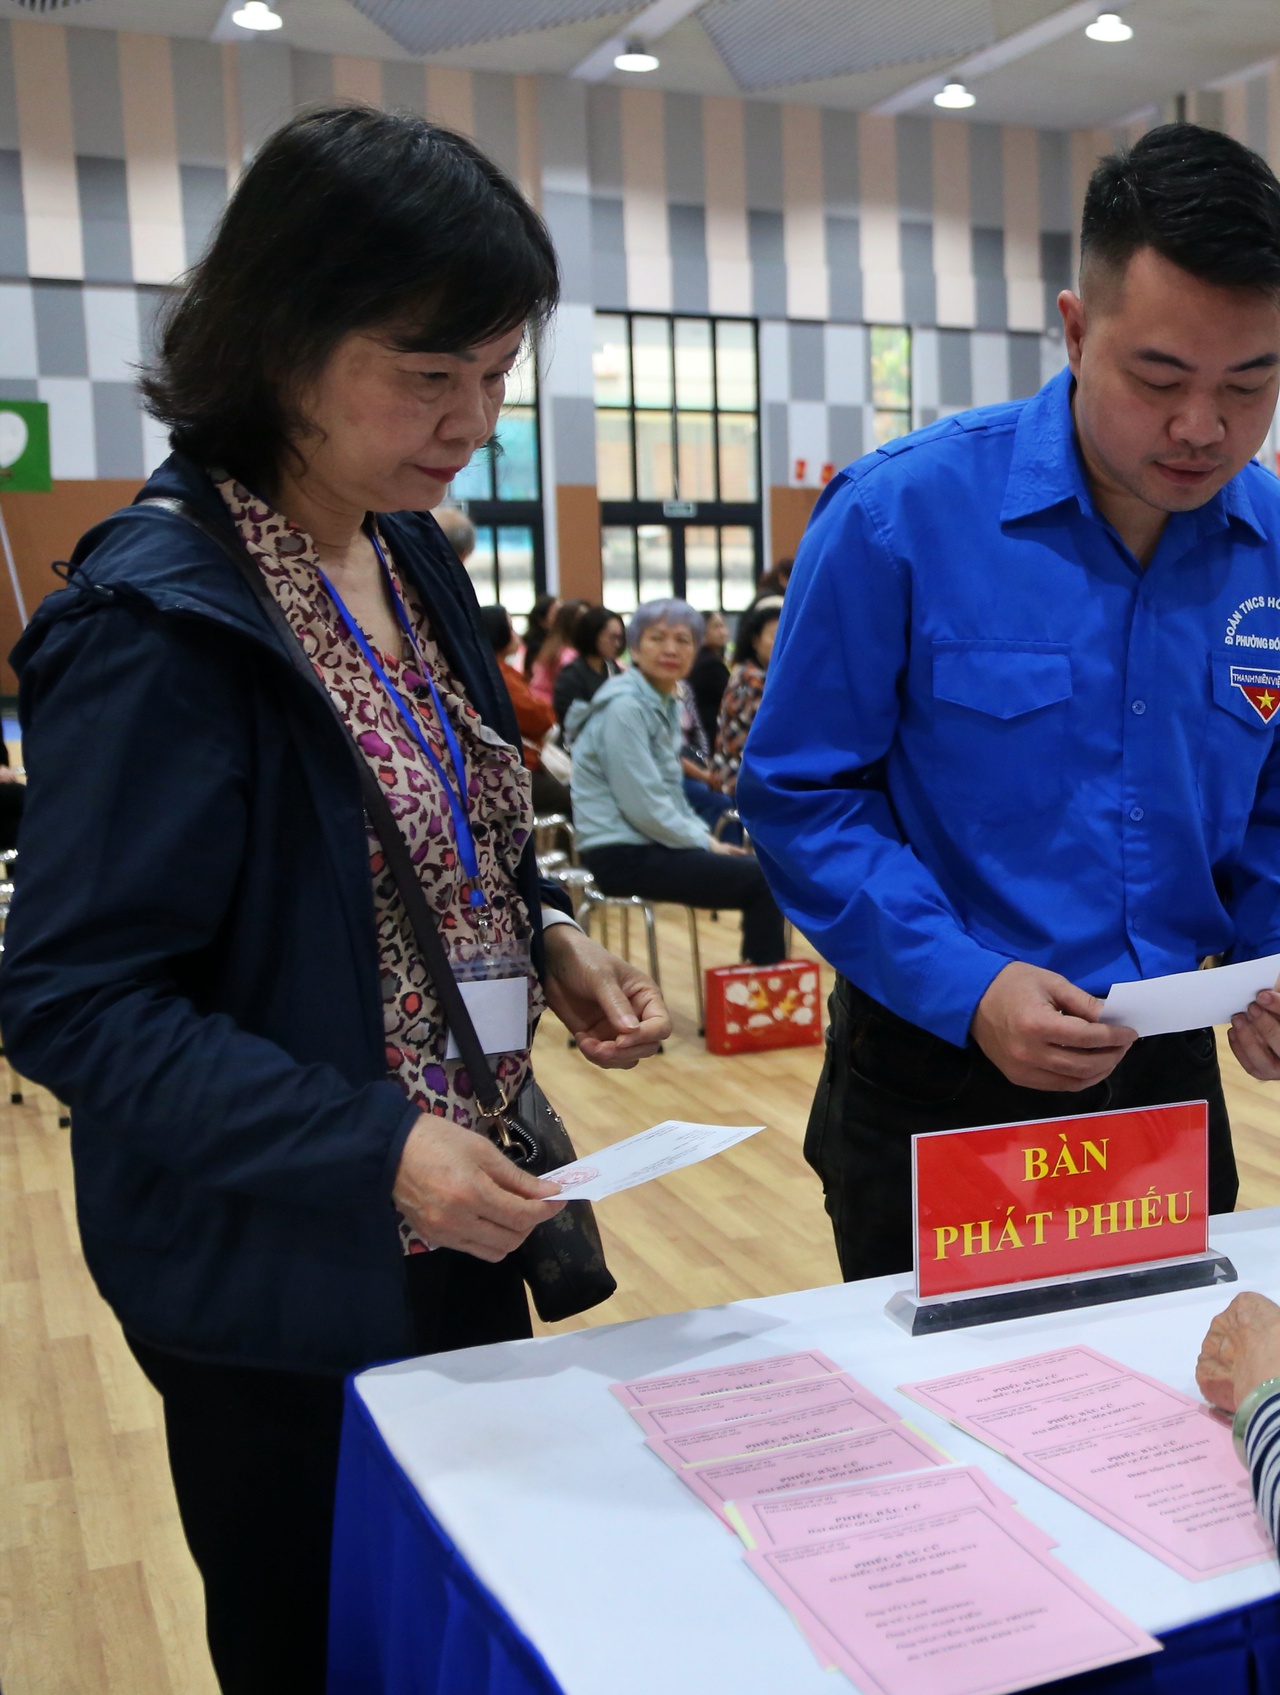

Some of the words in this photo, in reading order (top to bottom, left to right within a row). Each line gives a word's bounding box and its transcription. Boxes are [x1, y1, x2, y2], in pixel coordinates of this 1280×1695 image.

[1225, 610, 1243, 645] ĐOÀN
[1239, 595, 1265, 614] TNCS
[1235, 633, 1268, 649] PHƯỜNG
[1021, 1133, 1110, 1182] BÀN
[932, 1205, 1053, 1261] PHÁT
[1065, 1185, 1193, 1241] PHIẾU
